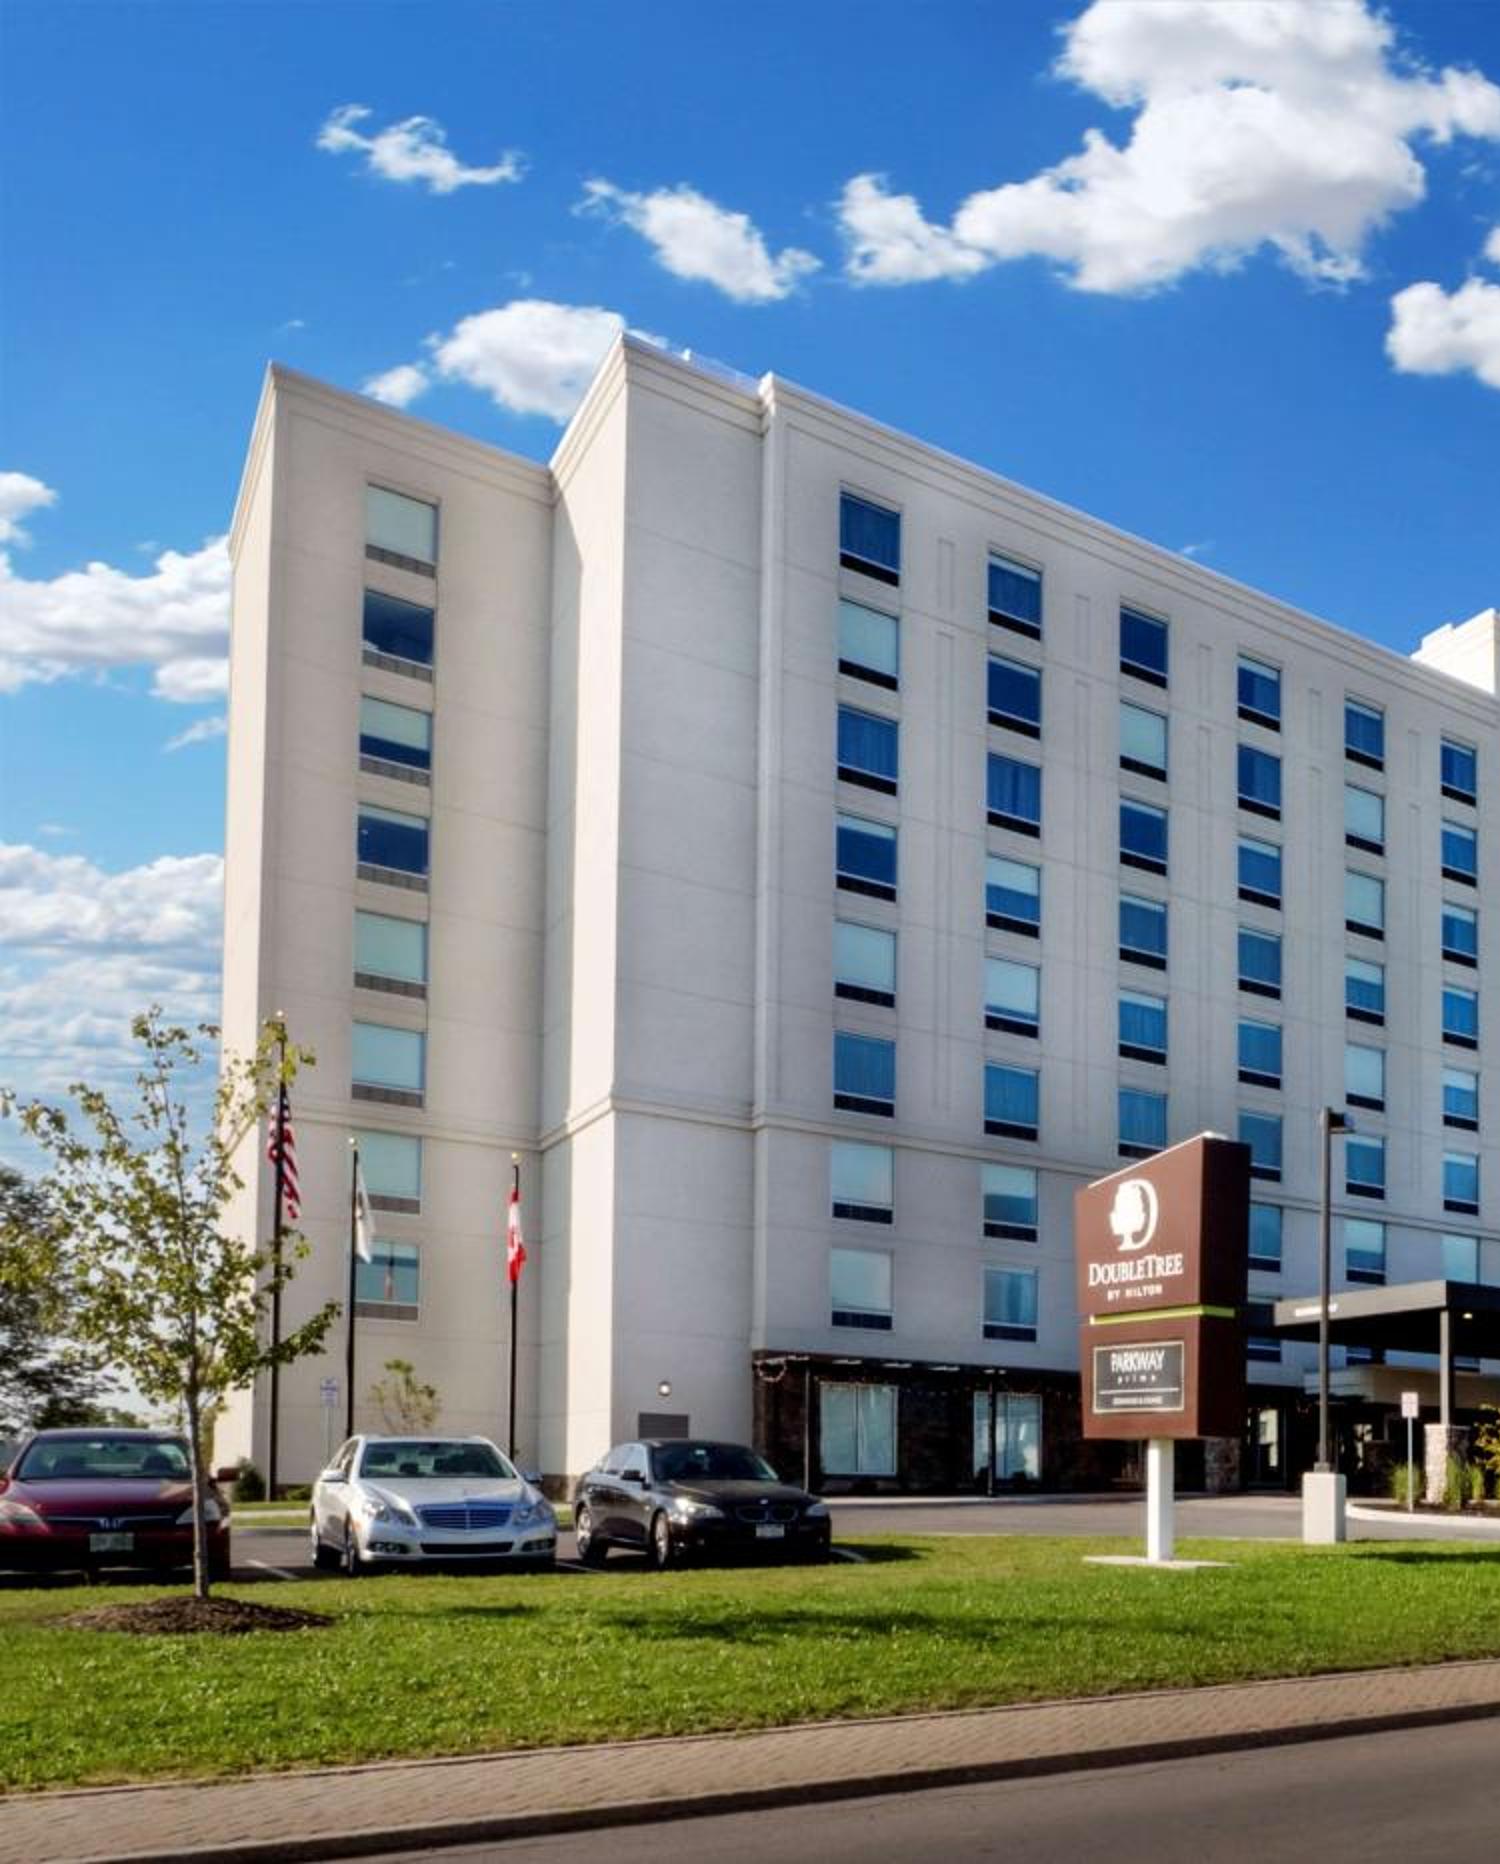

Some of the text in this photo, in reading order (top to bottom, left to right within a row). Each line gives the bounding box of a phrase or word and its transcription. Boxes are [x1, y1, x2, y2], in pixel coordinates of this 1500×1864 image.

[1088, 1253, 1184, 1287] DOUBLETREE
[1107, 1284, 1163, 1302] BY HILTON
[1111, 1349, 1166, 1374] PARKWAY
